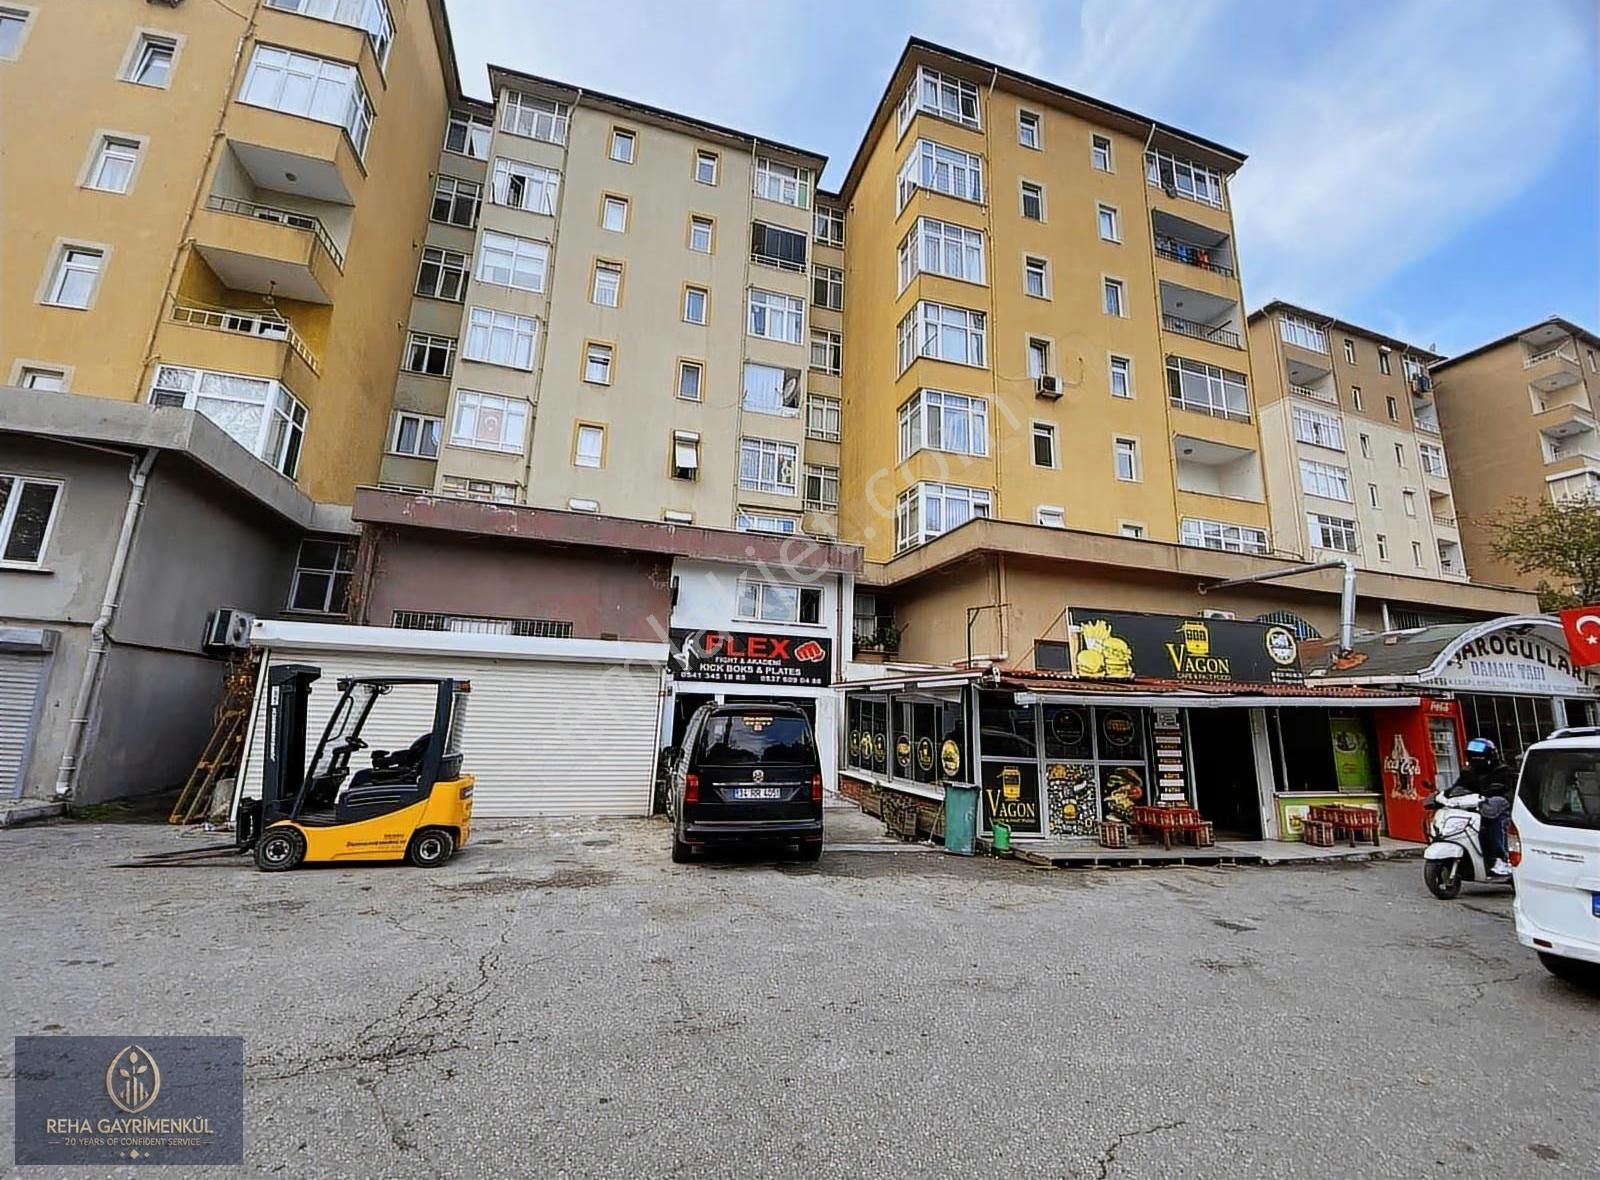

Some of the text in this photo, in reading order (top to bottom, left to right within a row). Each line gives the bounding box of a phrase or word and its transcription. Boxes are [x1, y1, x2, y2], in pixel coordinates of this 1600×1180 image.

[699, 663, 724, 673] KICK
[756, 666, 763, 675] &
[765, 667, 801, 676] PLATES
[1165, 643, 1230, 674] VAGON
[985, 789, 1035, 818] VAGON
